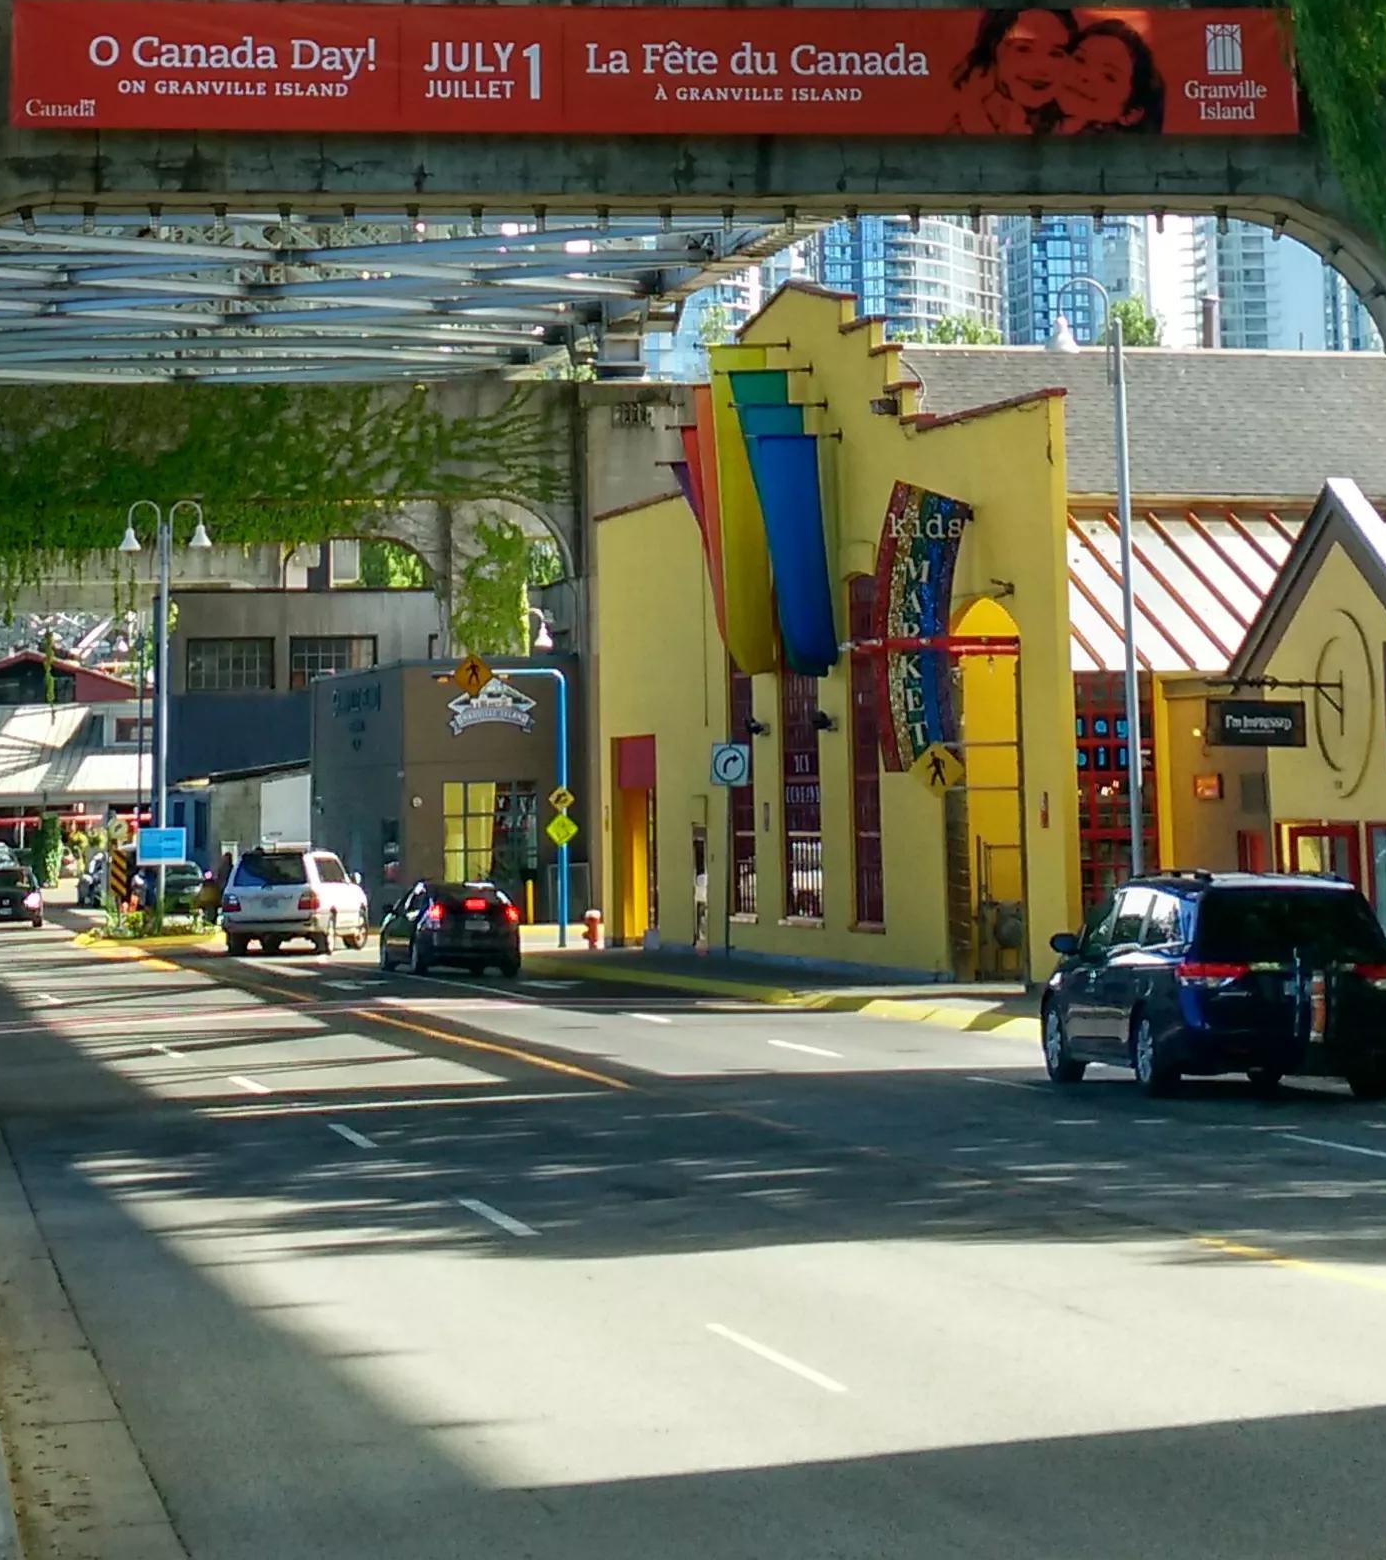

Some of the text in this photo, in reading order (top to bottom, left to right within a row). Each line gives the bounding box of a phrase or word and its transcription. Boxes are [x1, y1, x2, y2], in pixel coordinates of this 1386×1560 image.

[88, 35, 376, 80] O Canada Day!
[585, 40, 930, 77] La Fête du Canada
[423, 42, 542, 101] JULY 1
[117, 80, 350, 97] ON GRANVILLE ISLAND
[424, 80, 515, 100] JUILLET
[654, 83, 863, 102] À GRANVILLE ISLAND
[1184, 80, 1268, 100] Granville
[24, 99, 95, 118] Canada
[1199, 101, 1256, 121] Island
[888, 512, 964, 540] kids
